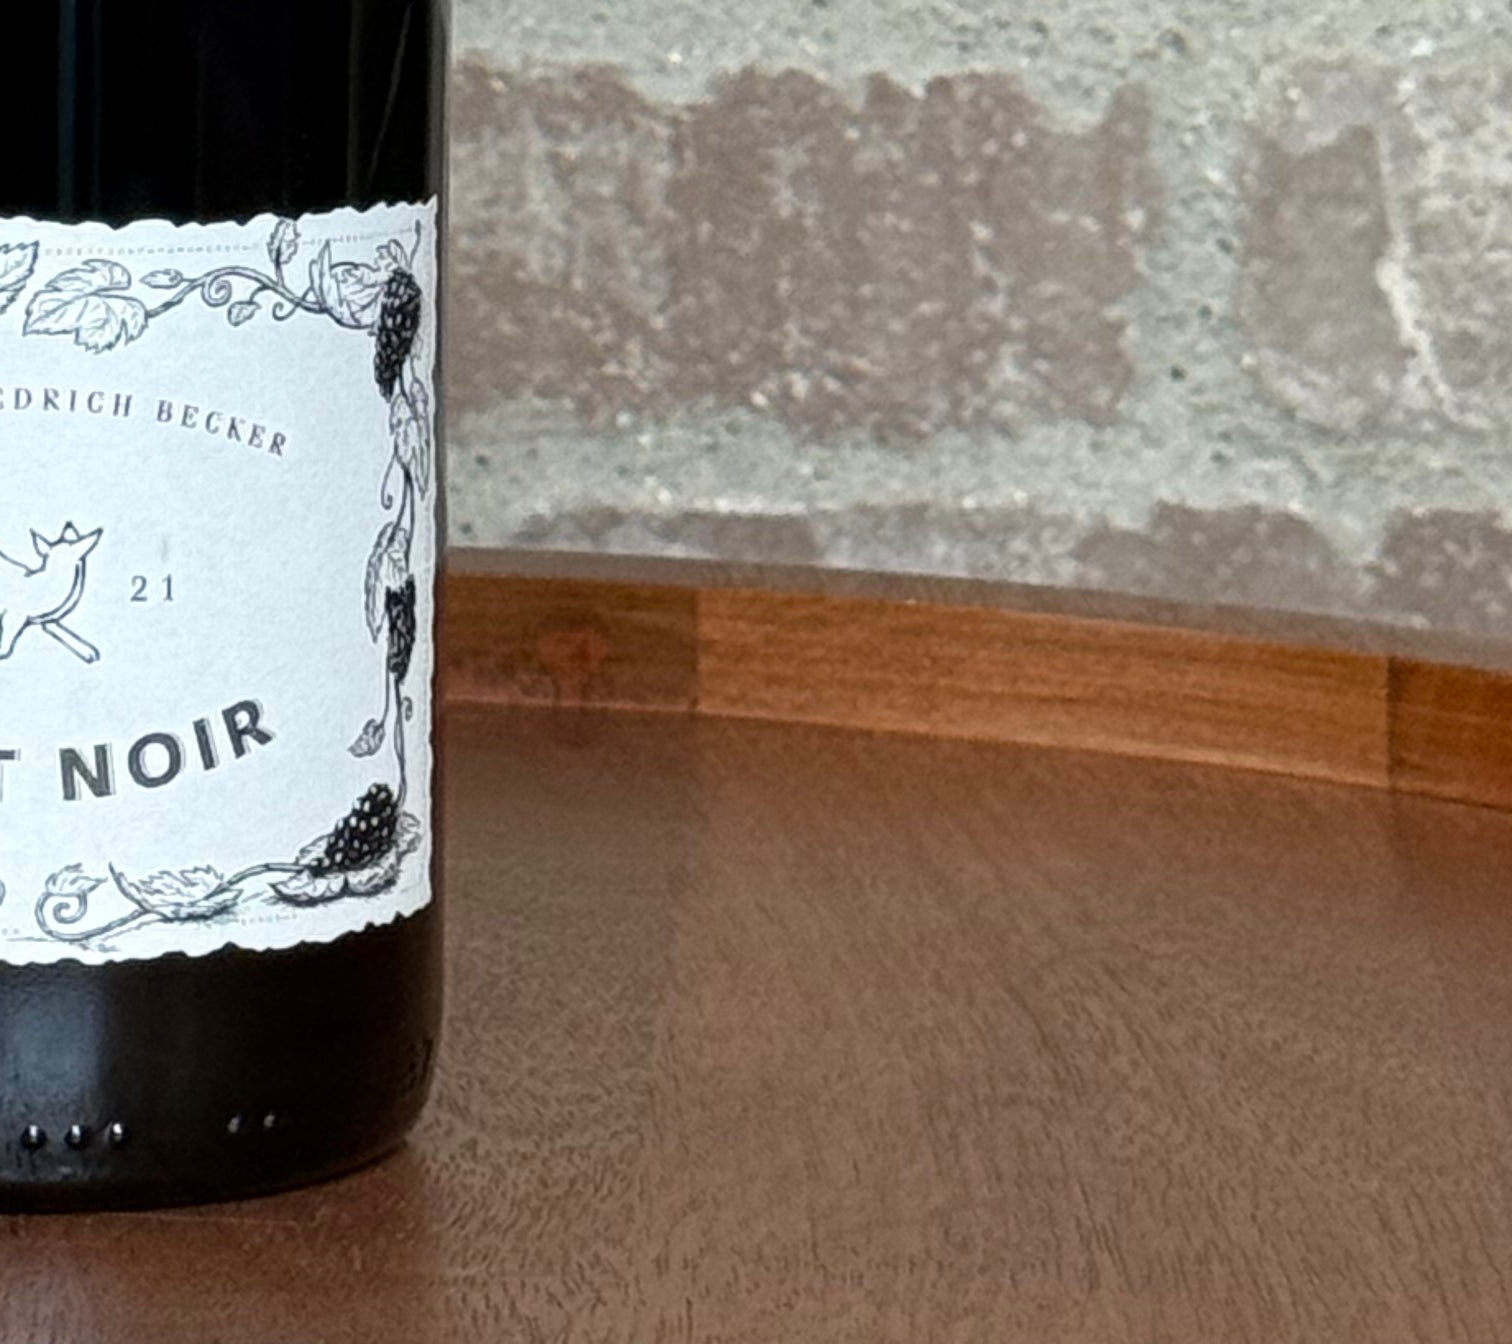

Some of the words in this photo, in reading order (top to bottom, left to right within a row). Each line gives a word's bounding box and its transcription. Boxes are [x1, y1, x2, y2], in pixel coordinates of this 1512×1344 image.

[156, 399, 287, 457] BECKER
[129, 574, 175, 603] 21
[58, 698, 276, 802] NOIR
